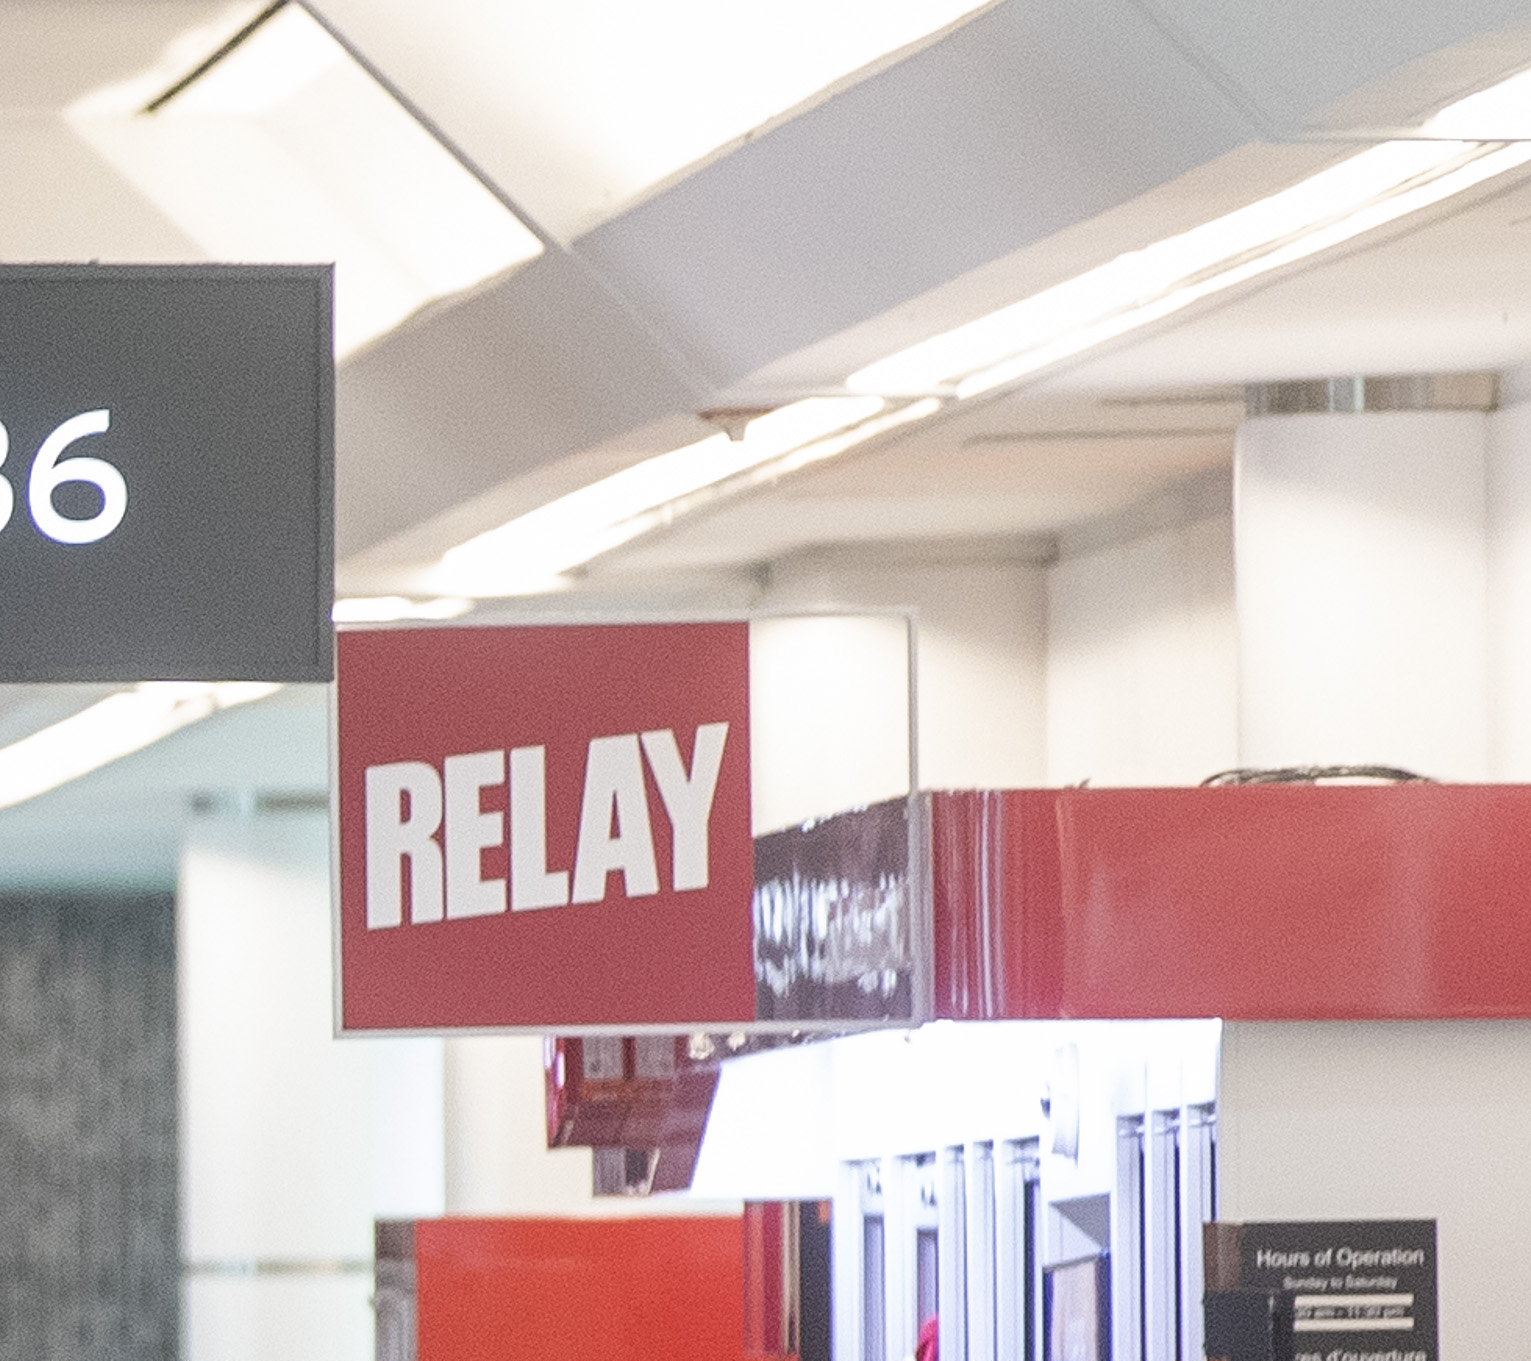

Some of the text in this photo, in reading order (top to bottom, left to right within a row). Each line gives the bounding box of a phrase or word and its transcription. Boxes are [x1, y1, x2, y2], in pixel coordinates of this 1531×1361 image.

[365, 722, 729, 930] RELAY
[1258, 1247, 1425, 1269] Hours of Operation
